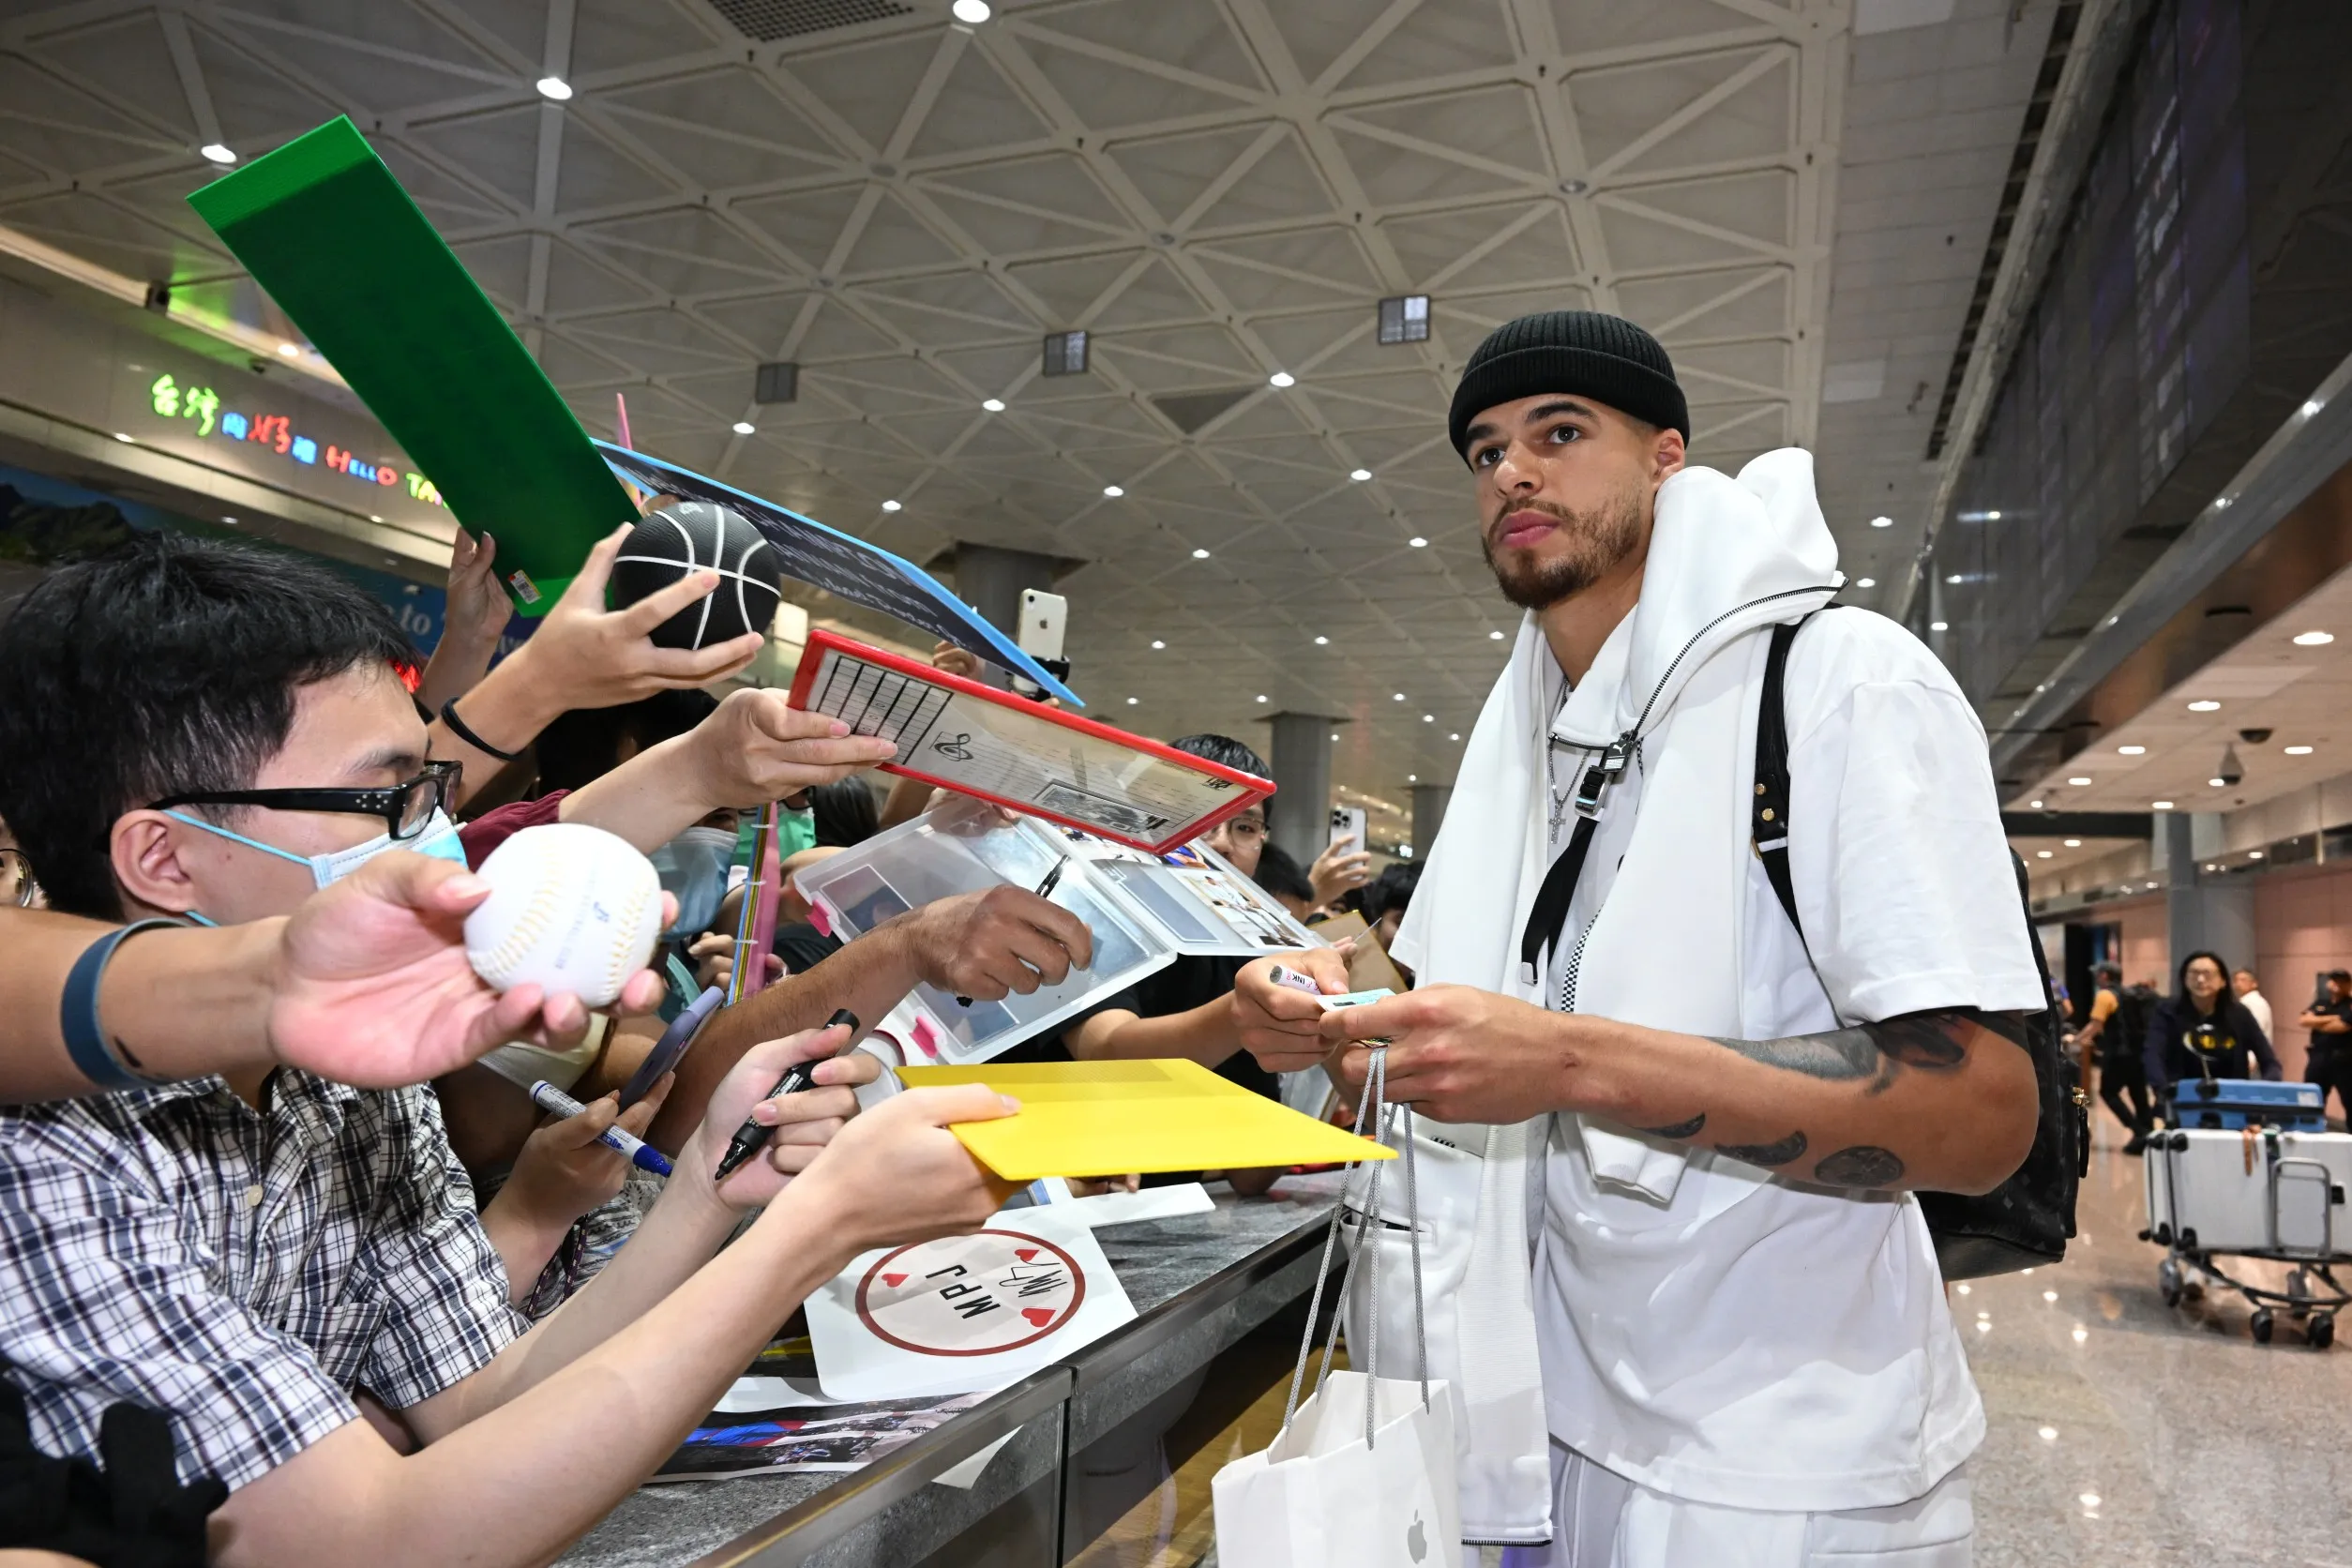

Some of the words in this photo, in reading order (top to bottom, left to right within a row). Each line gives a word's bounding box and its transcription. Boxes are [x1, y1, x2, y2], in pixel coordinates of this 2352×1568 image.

[325, 445, 398, 487] HELLO
[400, 603, 431, 636] to
[1291, 973, 1305, 985] INK
[925, 1263, 1001, 1319] MPJ
